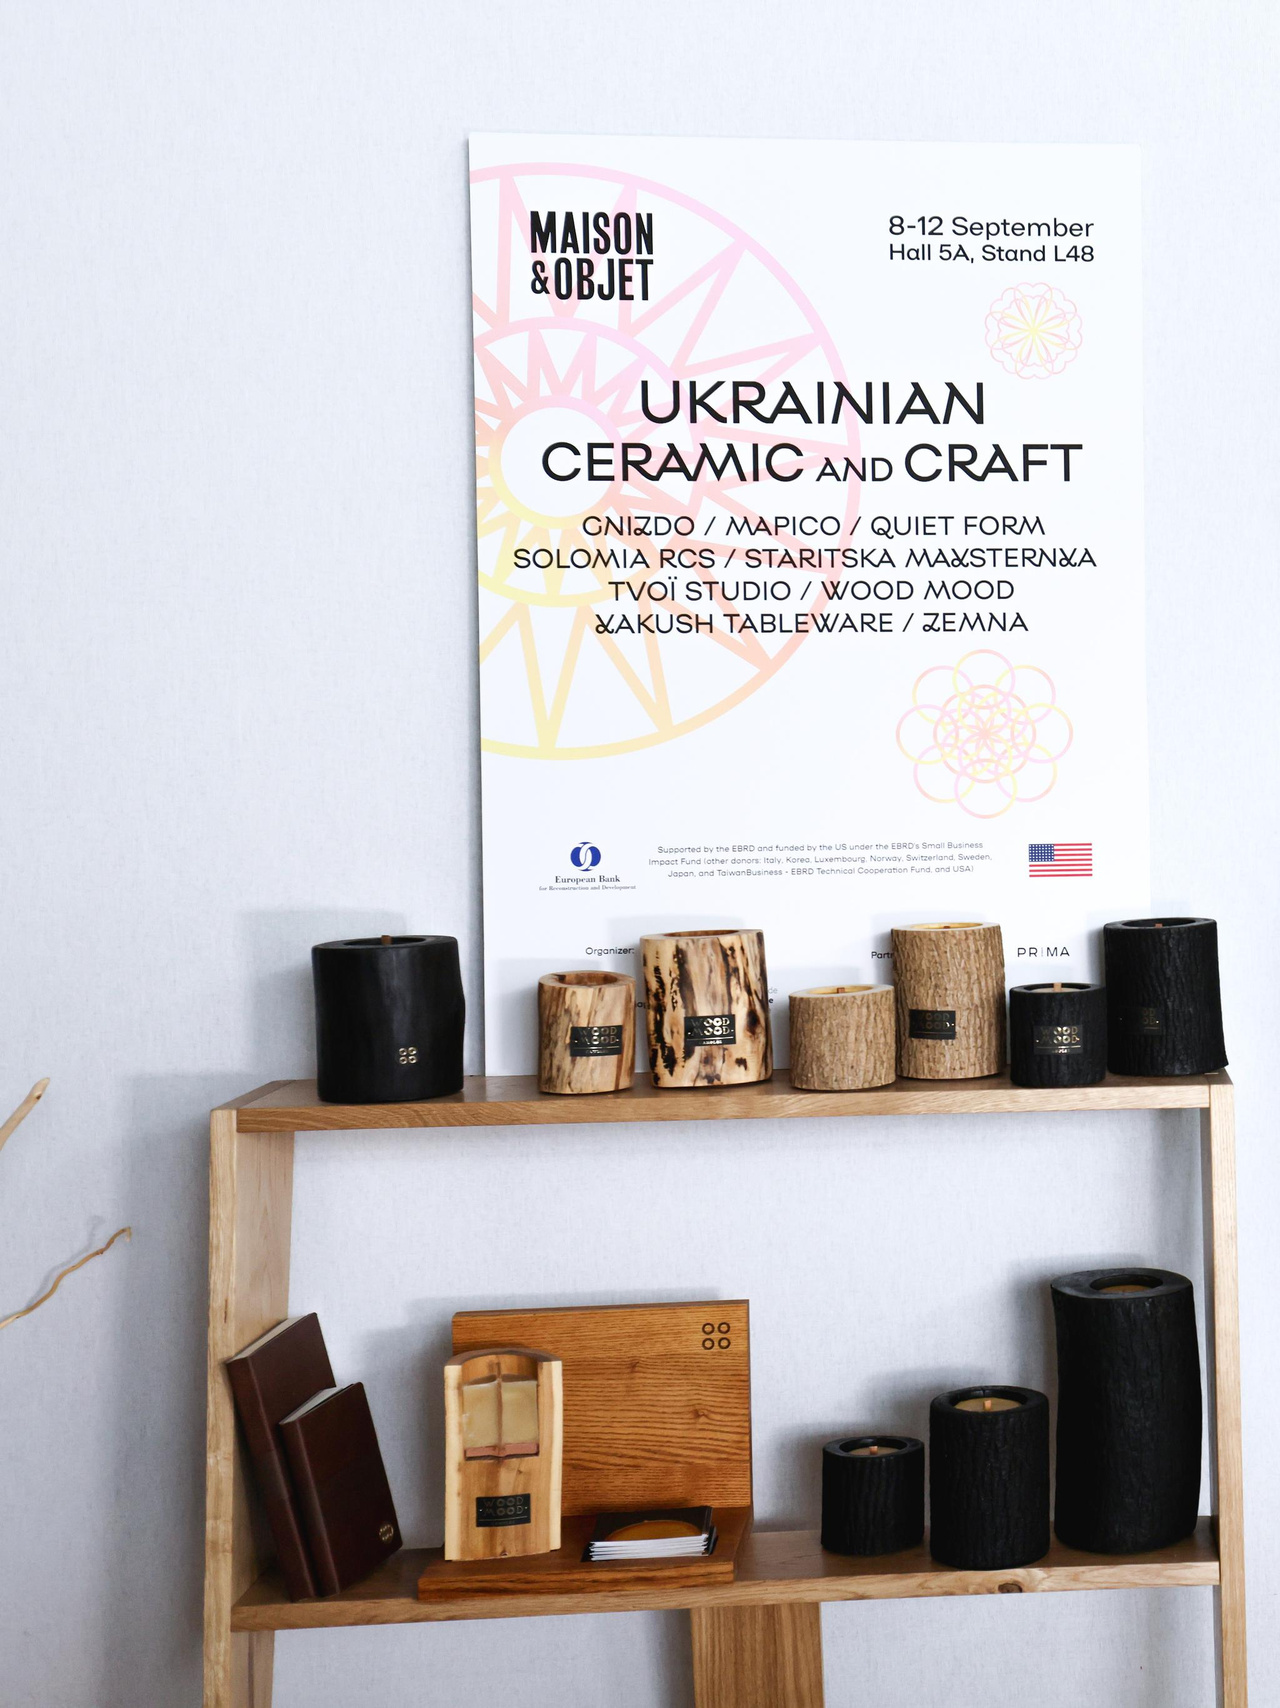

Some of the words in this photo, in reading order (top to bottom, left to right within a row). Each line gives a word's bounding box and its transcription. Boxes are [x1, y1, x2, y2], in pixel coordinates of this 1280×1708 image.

[530, 211, 654, 256] MAISON
[889, 215, 944, 236] 8-12
[952, 216, 1095, 241] September
[889, 243, 931, 261] Hall
[939, 243, 974, 264] 5A,
[981, 245, 1046, 262] Stand
[1054, 246, 1095, 263] L48
[530, 257, 654, 301] &OBJET
[641, 380, 984, 425] UKRAINIAN
[542, 441, 804, 482] CERAMIC
[815, 456, 894, 483] AND
[904, 442, 1083, 483] CRAFT
[704, 516, 716, 536] /
[725, 515, 841, 536] MAPICO
[849, 516, 862, 536] /
[870, 515, 955, 540] QUIET
[964, 515, 1046, 536] FORM
[513, 548, 651, 569] SOLOMIA
[659, 548, 716, 569] RCS
[724, 548, 737, 569] /
[745, 548, 896, 569] STARITSKA
[607, 576, 676, 602] TVOÏ
[685, 580, 791, 602] STUDIO
[800, 580, 812, 601] /
[820, 580, 914, 601] WOOD
[923, 580, 1014, 600] MOOD
[722, 612, 893, 634] TABLEWARE
[902, 612, 914, 633] /
[922, 612, 1029, 633] ZEMNA
[657, 844, 702, 855] Supported
[703, 845, 714, 854] by
[716, 845, 730, 853] the
[731, 844, 756, 853] EBRD
[757, 844, 773, 852] and
[775, 843, 805, 852] funded
[806, 844, 817, 853] by
[819, 843, 833, 851] the
[834, 843, 848, 851] US
[849, 842, 873, 851] under
[875, 842, 889, 850] the
[891, 842, 920, 850] EBRD's
[921, 841, 945, 850] Small
[947, 841, 984, 849] Business
[648, 857, 679, 867] Impact
[680, 857, 702, 866] Fund
[703, 857, 728, 866] (other
[730, 856, 761, 866] donors:
[786, 856, 813, 865] Korea,
[814, 855, 868, 865] Luxembourg,
[870, 854, 904, 863] Norway,
[906, 853, 956, 862] Switzerland,
[957, 853, 993, 861] Sweden,
[555, 875, 596, 885] European
[598, 874, 621, 883] Bank
[667, 870, 697, 879] Japan,
[698, 869, 715, 877] and
[717, 867, 783, 877] TaiwanBusiness
[790, 867, 815, 876] EBRD
[816, 866, 856, 875] Technical
[857, 866, 909, 875] Cooperation
[910, 865, 933, 874] Fund,
[934, 865, 951, 873] and
[952, 864, 974, 873] USA)
[585, 946, 635, 957] Organizer:
